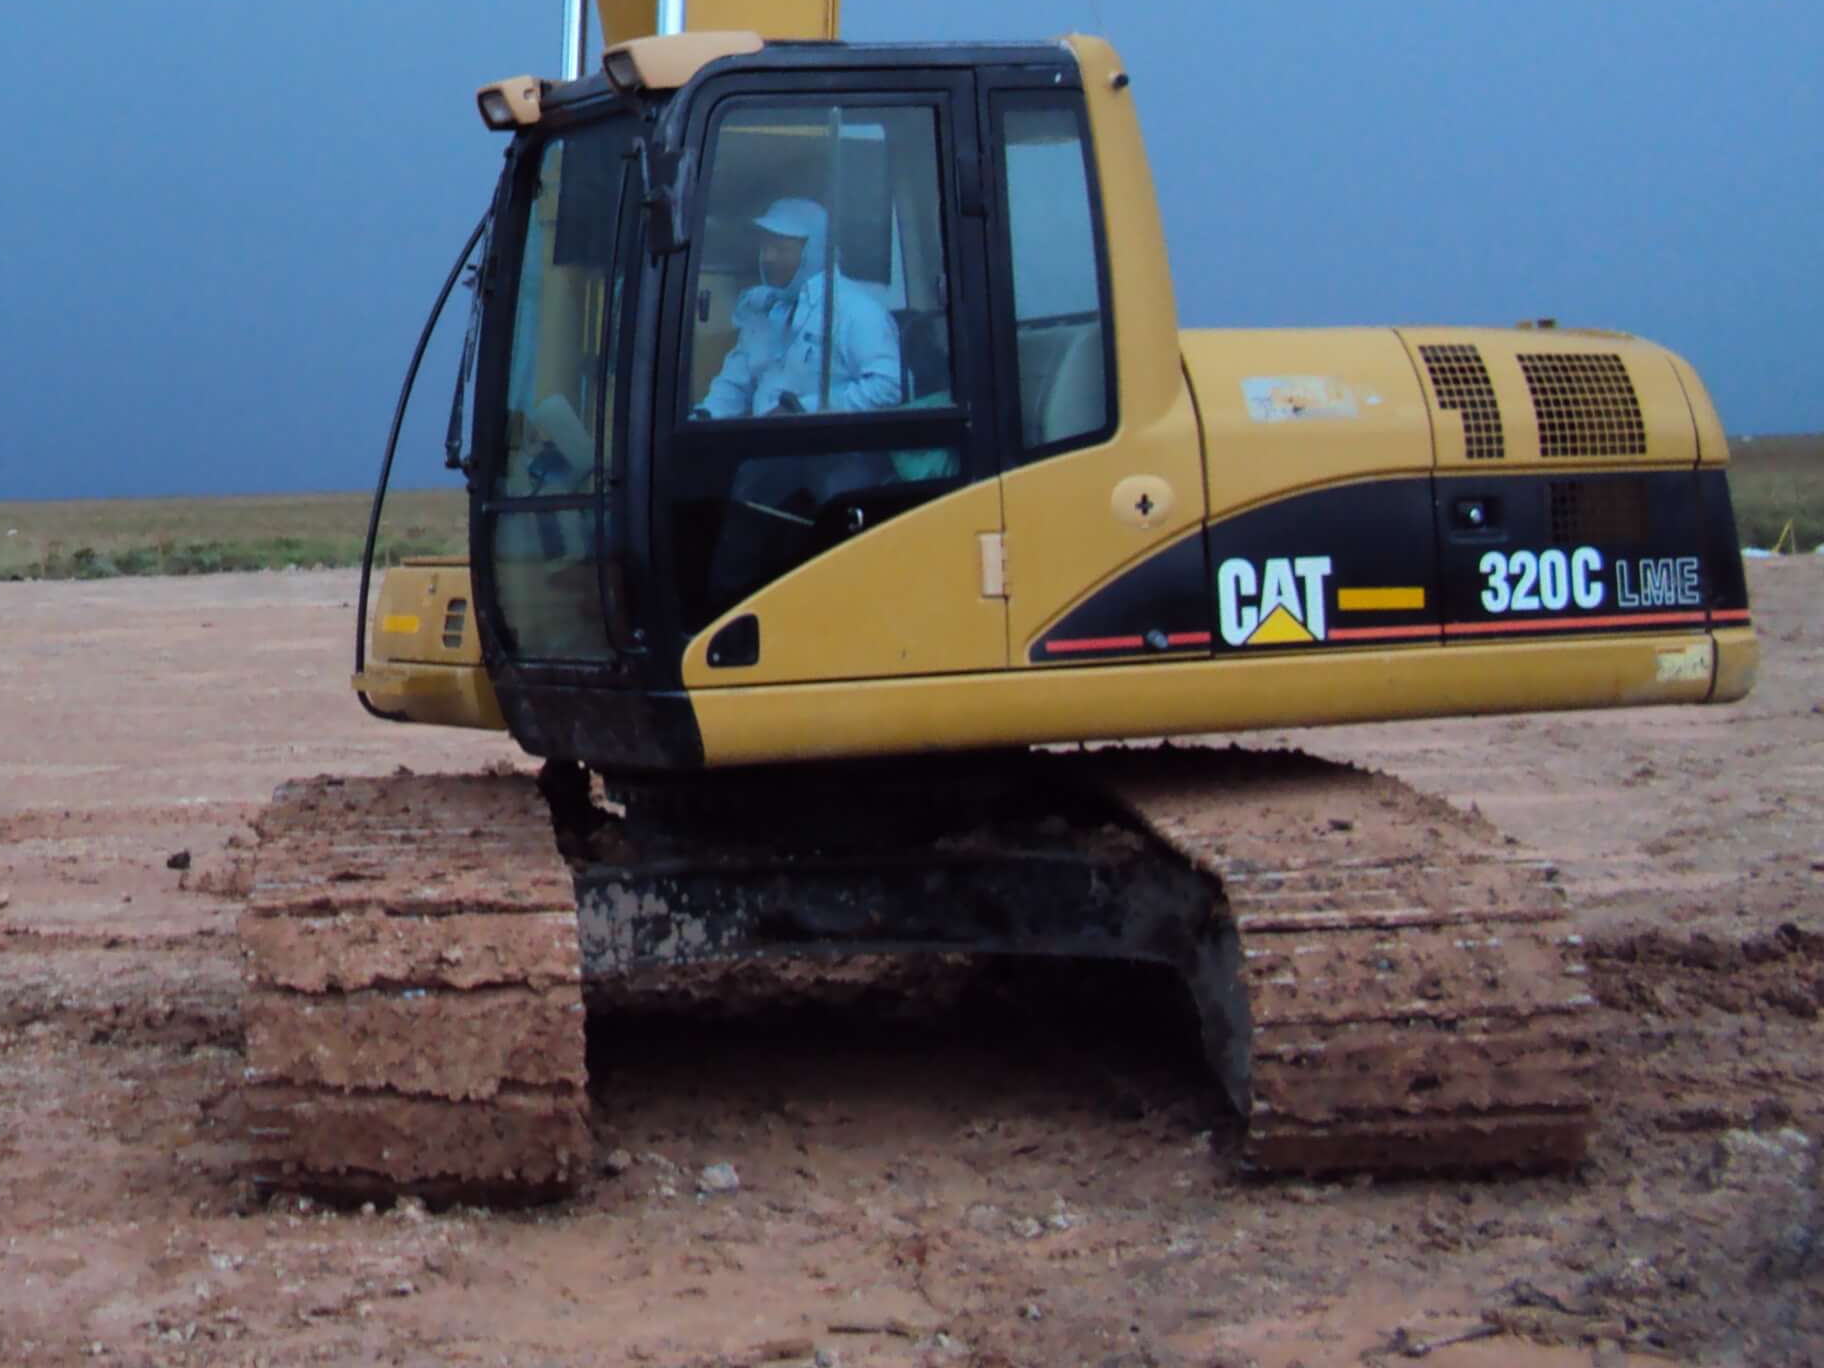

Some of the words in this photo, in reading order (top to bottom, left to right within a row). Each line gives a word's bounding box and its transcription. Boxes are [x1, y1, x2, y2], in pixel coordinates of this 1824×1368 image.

[1217, 555, 1333, 646] CAT
[1479, 547, 1604, 613] 320C
[1615, 557, 1702, 608] LME
